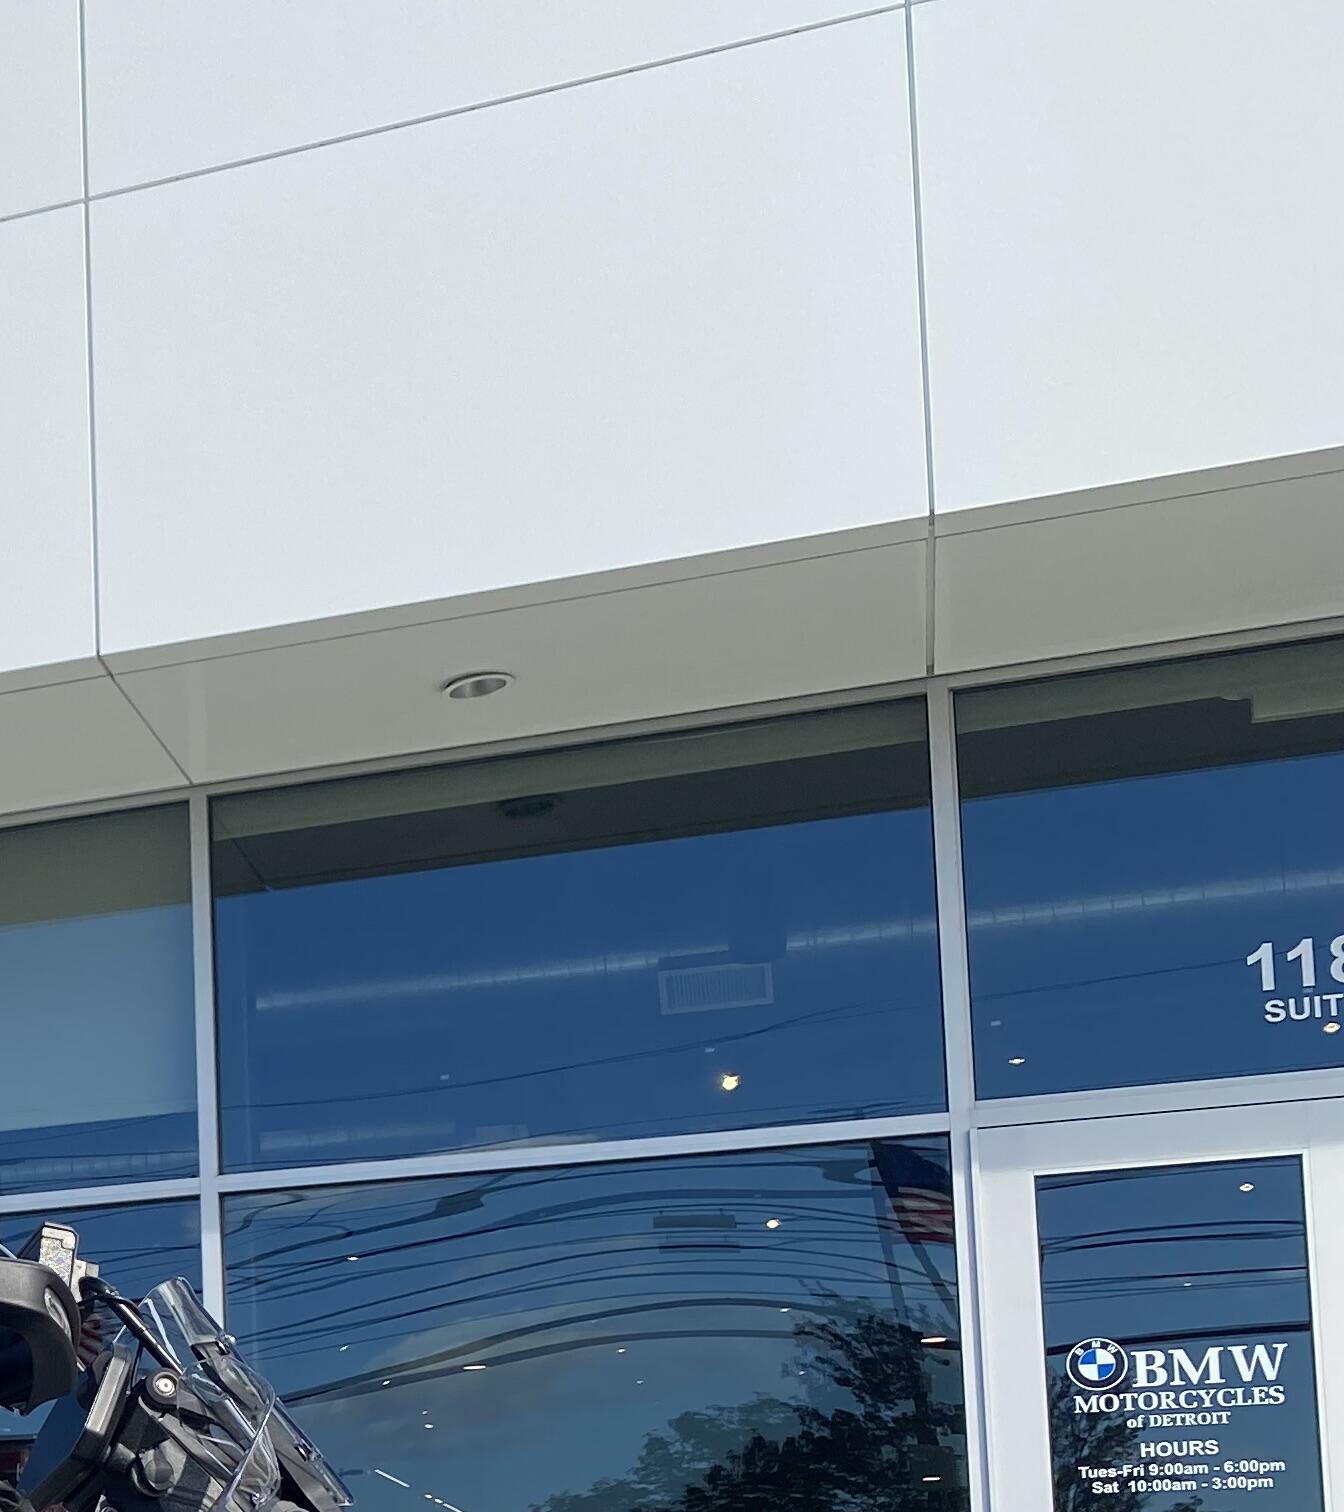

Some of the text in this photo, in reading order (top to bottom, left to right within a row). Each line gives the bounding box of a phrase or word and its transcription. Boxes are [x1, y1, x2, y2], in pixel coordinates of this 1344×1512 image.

[1264, 993, 1344, 1023] SUIT
[1130, 1343, 1288, 1388] BMW
[1073, 1385, 1286, 1414] MOTORCYCLES
[1126, 1411, 1231, 1429] of DETROIT
[1140, 1439, 1219, 1458] HOURS
[1078, 1463, 1145, 1479] Tues-Fri
[1148, 1463, 1209, 1476] 9:00am
[1224, 1460, 1286, 1474] 6:00pm
[1092, 1481, 1119, 1494] Sat
[1128, 1478, 1197, 1493] 10:00am
[1212, 1476, 1274, 1491] 3:00pm
